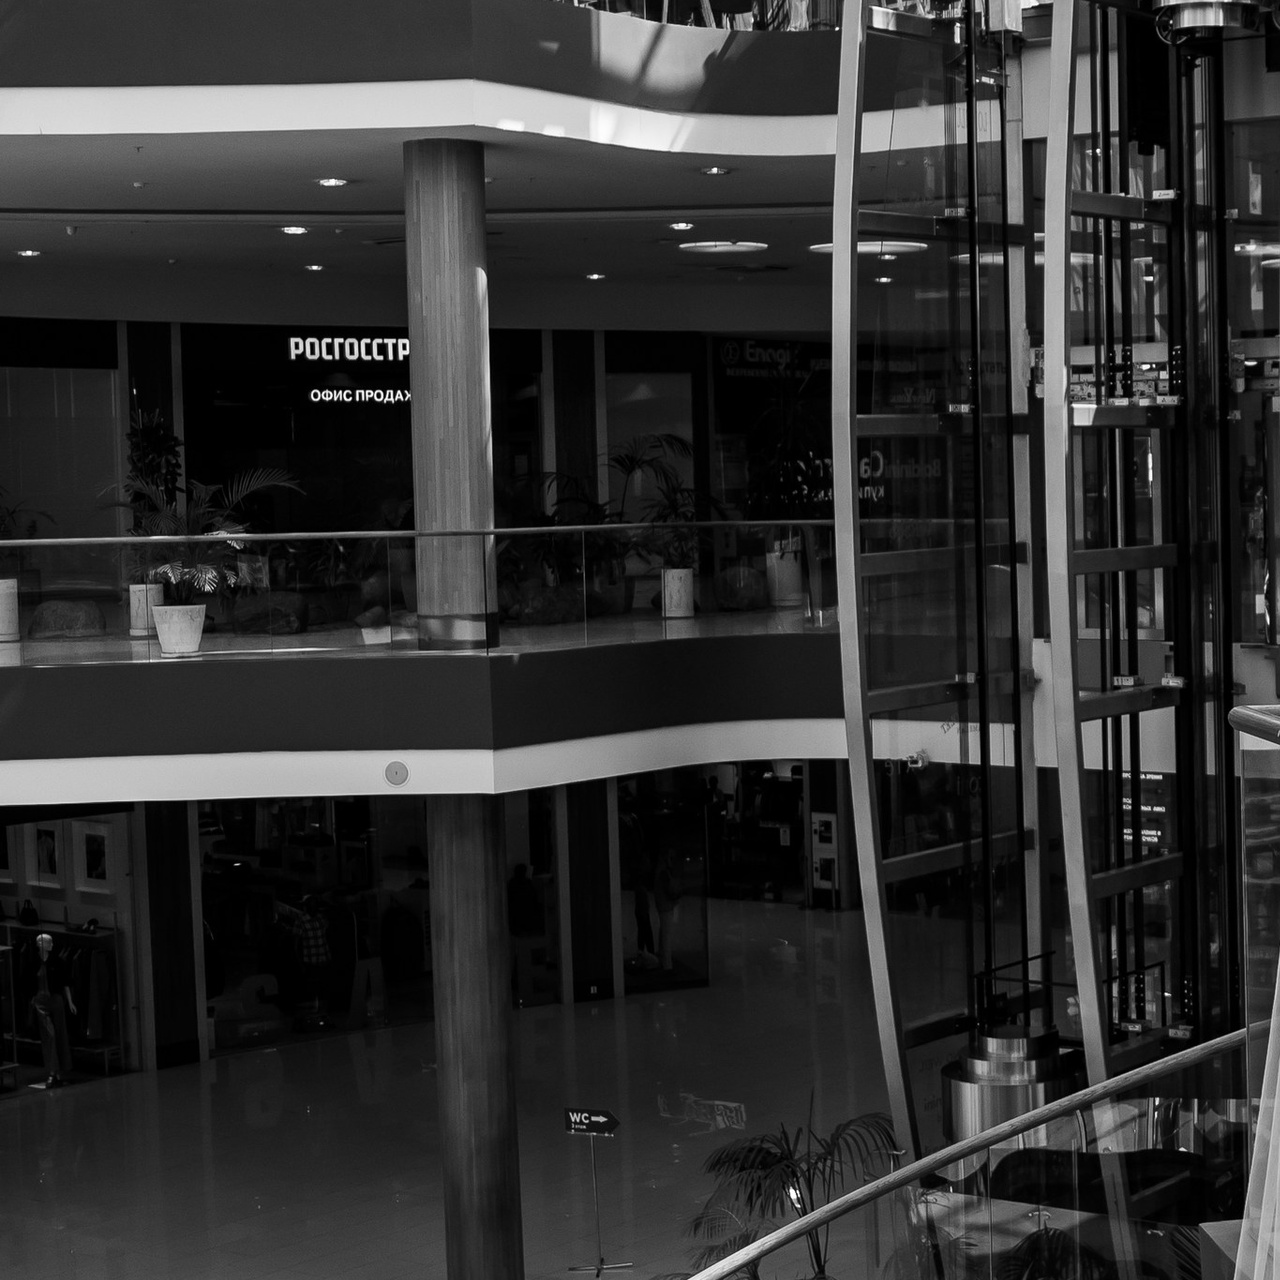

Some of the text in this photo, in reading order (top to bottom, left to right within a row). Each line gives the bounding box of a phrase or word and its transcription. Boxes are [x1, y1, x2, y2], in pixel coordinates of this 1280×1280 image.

[290, 337, 410, 360] РОСГОССТР
[310, 389, 352, 402] ОФИС
[569, 1111, 590, 1123] WC
